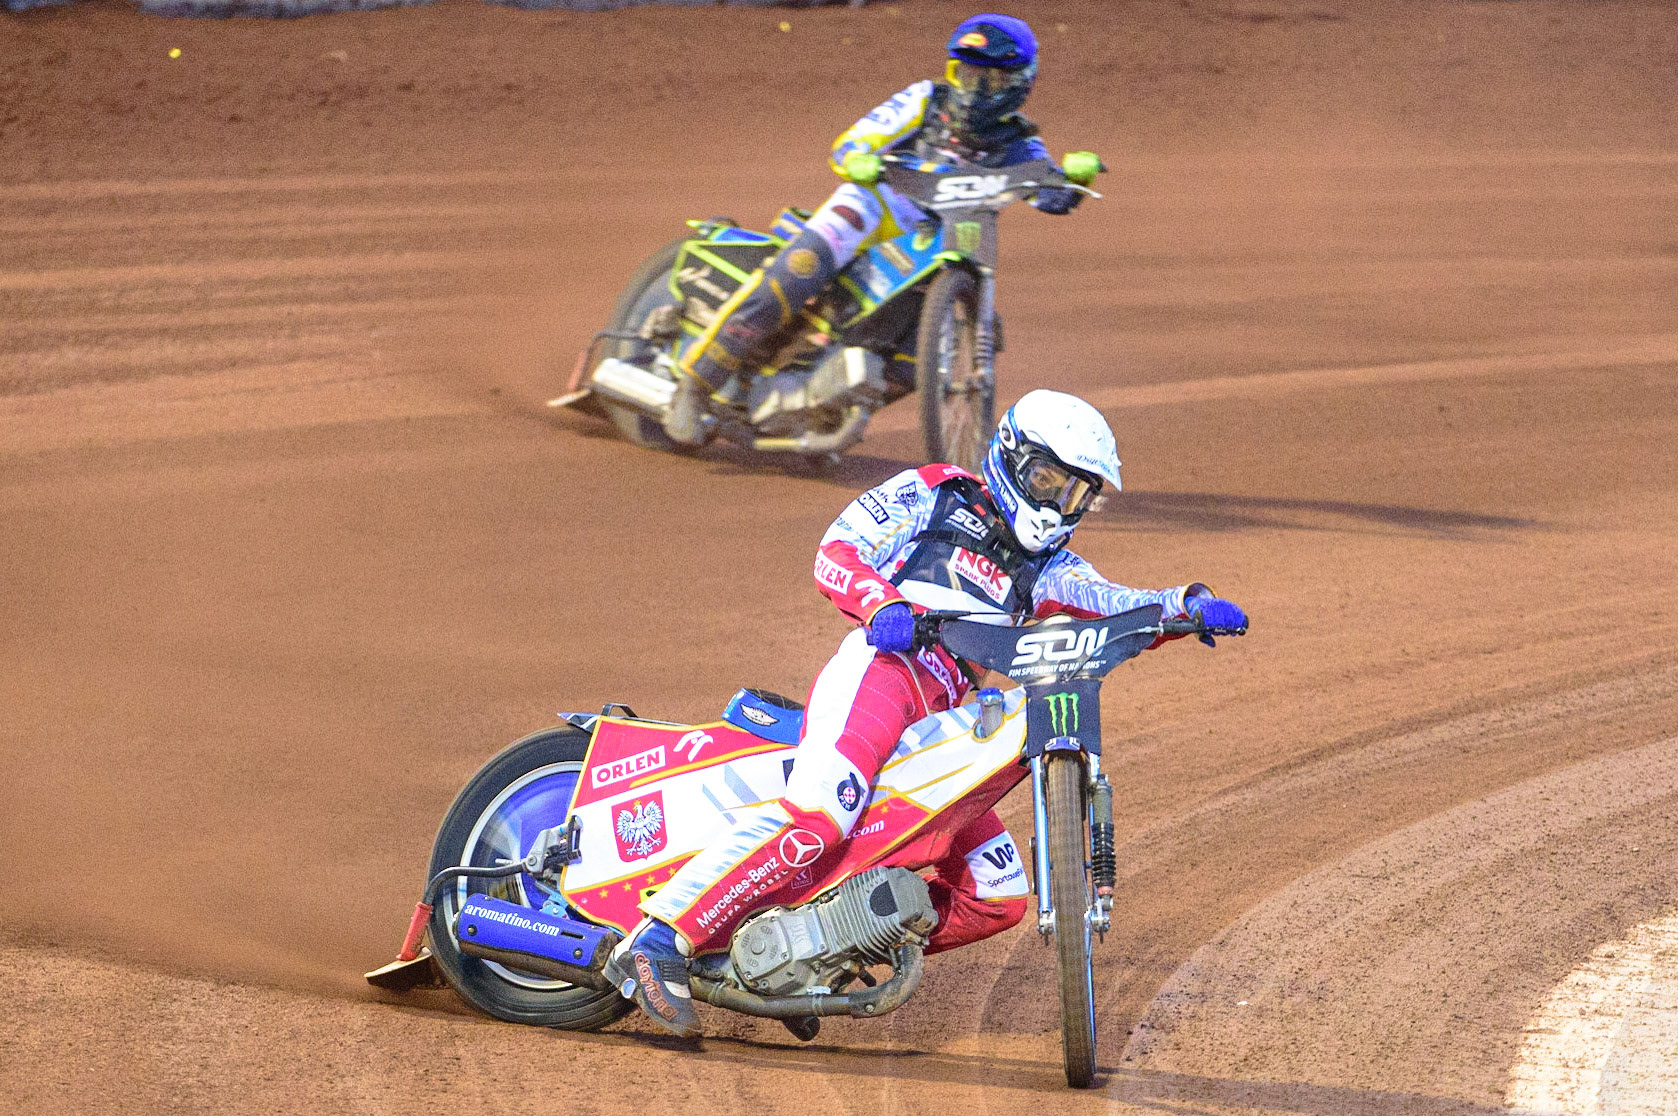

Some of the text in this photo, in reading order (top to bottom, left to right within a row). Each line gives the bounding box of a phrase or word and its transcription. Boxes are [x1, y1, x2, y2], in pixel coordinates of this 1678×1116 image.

[955, 563, 1000, 599] SPARK PLUGS
[957, 547, 1009, 591] NGK
[1008, 668, 1021, 677] FIM
[1021, 664, 1059, 676] SPEEDWAY
[1059, 663, 1068, 672] OF
[596, 751, 660, 783] ORLEN
[696, 856, 780, 928] Mercedes-Benz
[464, 904, 560, 937] aromatino.com
[709, 905, 740, 934] GRUPA
[635, 953, 678, 1020] daytona
